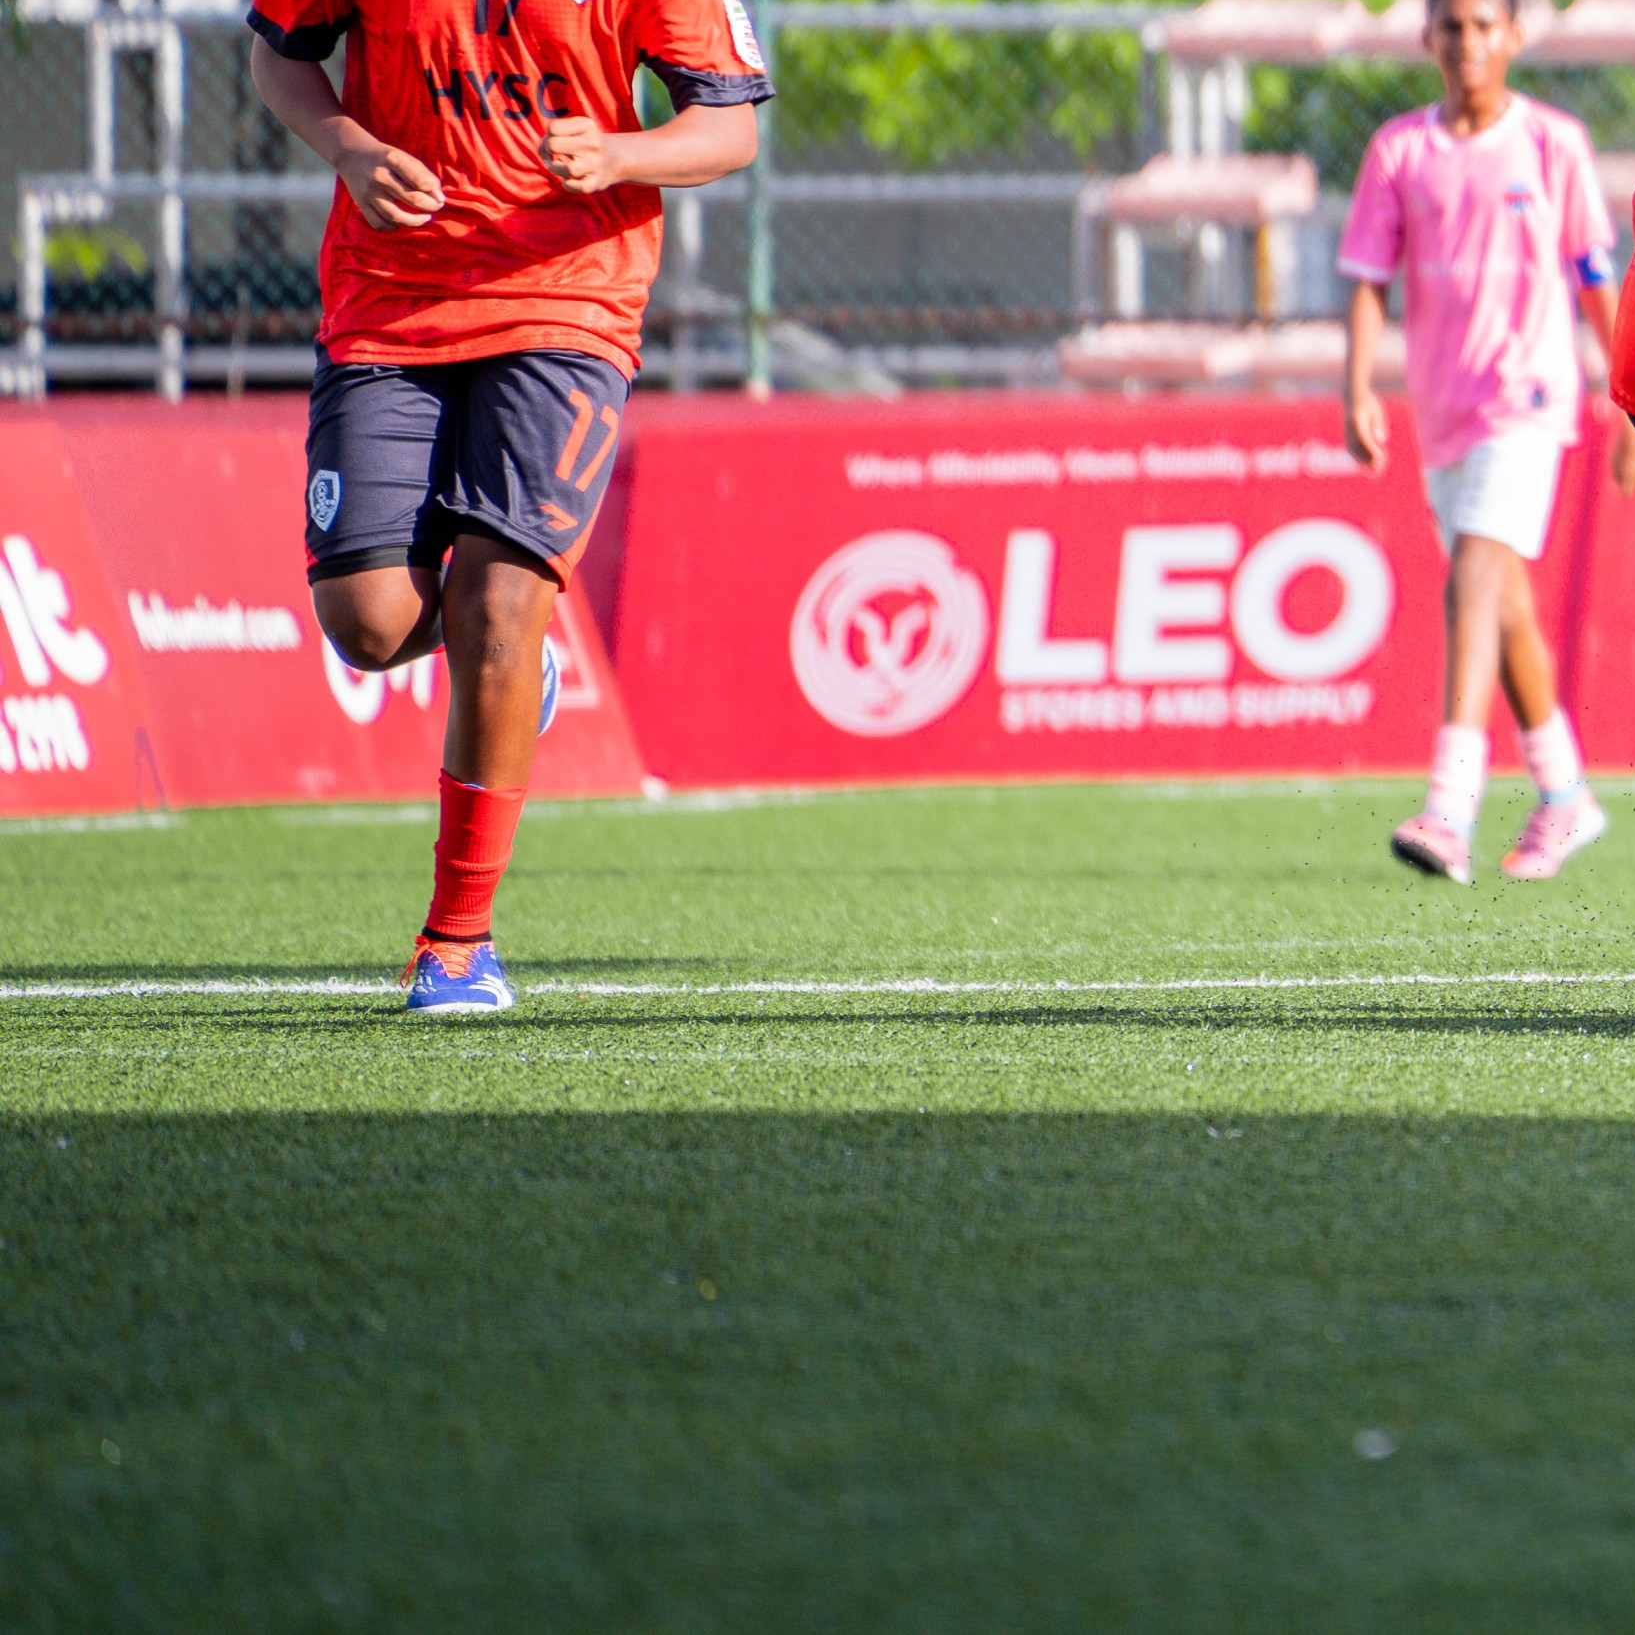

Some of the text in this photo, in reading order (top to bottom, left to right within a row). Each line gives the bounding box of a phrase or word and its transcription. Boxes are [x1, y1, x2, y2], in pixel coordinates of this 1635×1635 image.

[425, 68, 569, 120] HYSC
[555, 389, 620, 491] 17
[996, 517, 1395, 685] LEO
[1146, 684, 1230, 728] AND
